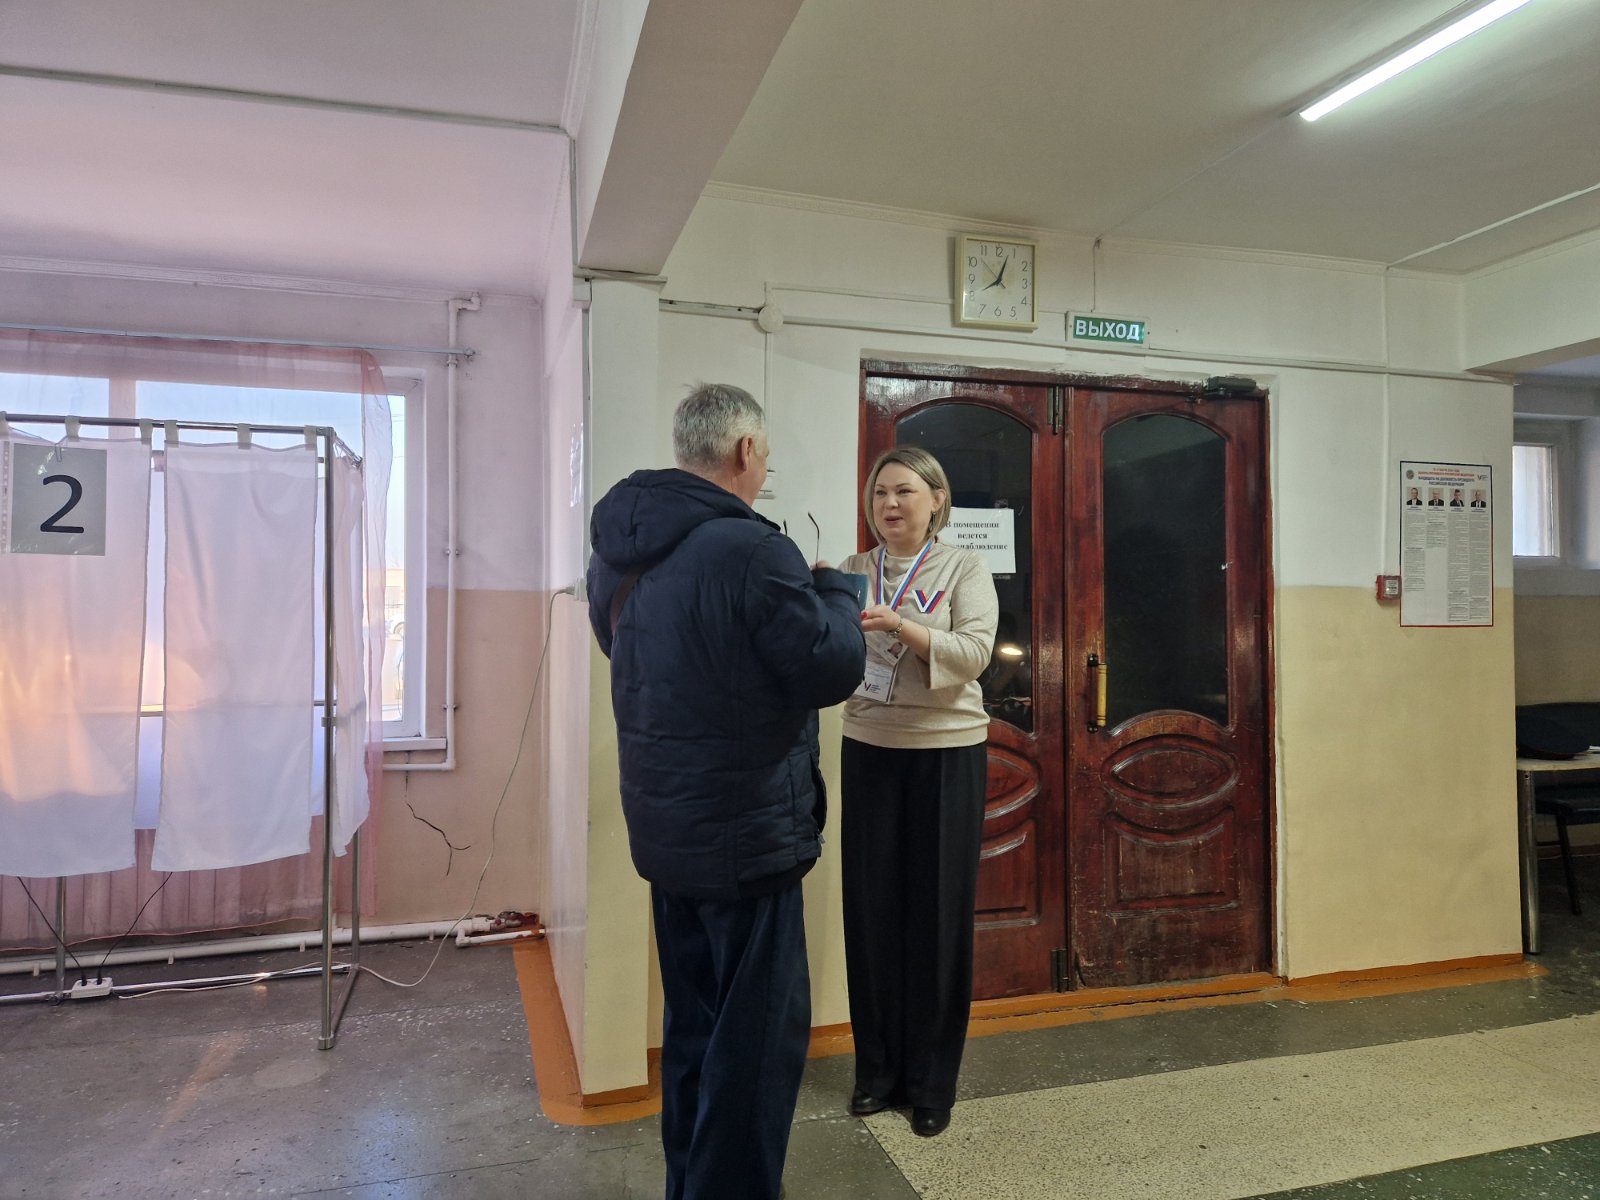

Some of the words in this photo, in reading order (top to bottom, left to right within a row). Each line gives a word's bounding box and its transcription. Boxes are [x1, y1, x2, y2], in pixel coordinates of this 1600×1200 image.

[980, 245, 988, 257] 11
[995, 247, 1004, 258] 12
[968, 256, 978, 268] 10
[1021, 261, 1028, 272] 2
[968, 273, 976, 285] 9
[1021, 278, 1028, 289] 3
[968, 290, 976, 302] 8
[1020, 296, 1028, 306] 4
[979, 304, 987, 315] 7
[994, 306, 1002, 317] 6
[1009, 306, 1017, 317] 5
[1075, 319, 1140, 341] ВЫХОД
[40, 474, 85, 534] 2
[953, 521, 1000, 529] помещении
[956, 542, 1008, 551] наблюдение
